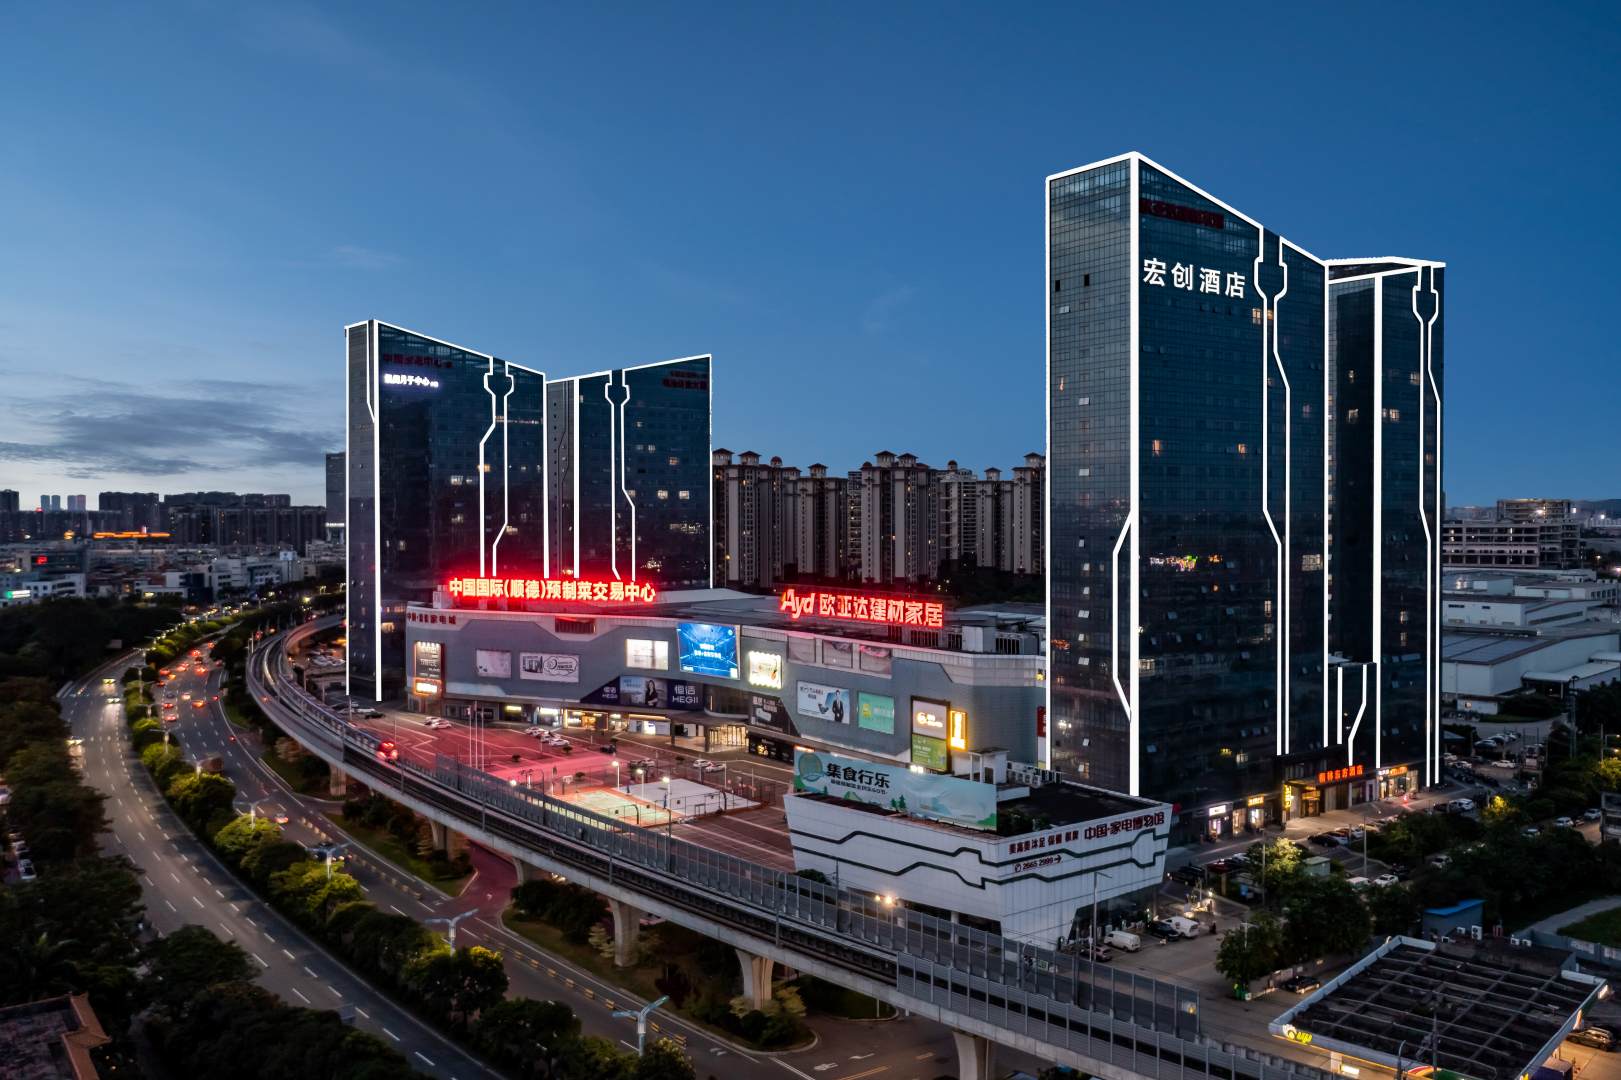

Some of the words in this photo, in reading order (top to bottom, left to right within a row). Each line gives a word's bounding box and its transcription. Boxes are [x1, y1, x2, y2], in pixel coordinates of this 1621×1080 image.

[1143, 257, 1245, 298] 宏创酒店
[384, 373, 431, 386] 月子中心
[449, 577, 657, 603] 中国国际(顺德)预制菜交易中心
[780, 588, 817, 618] Ayd
[819, 593, 944, 627] 欧亚达建材家居
[826, 762, 891, 789] 集食行乐
